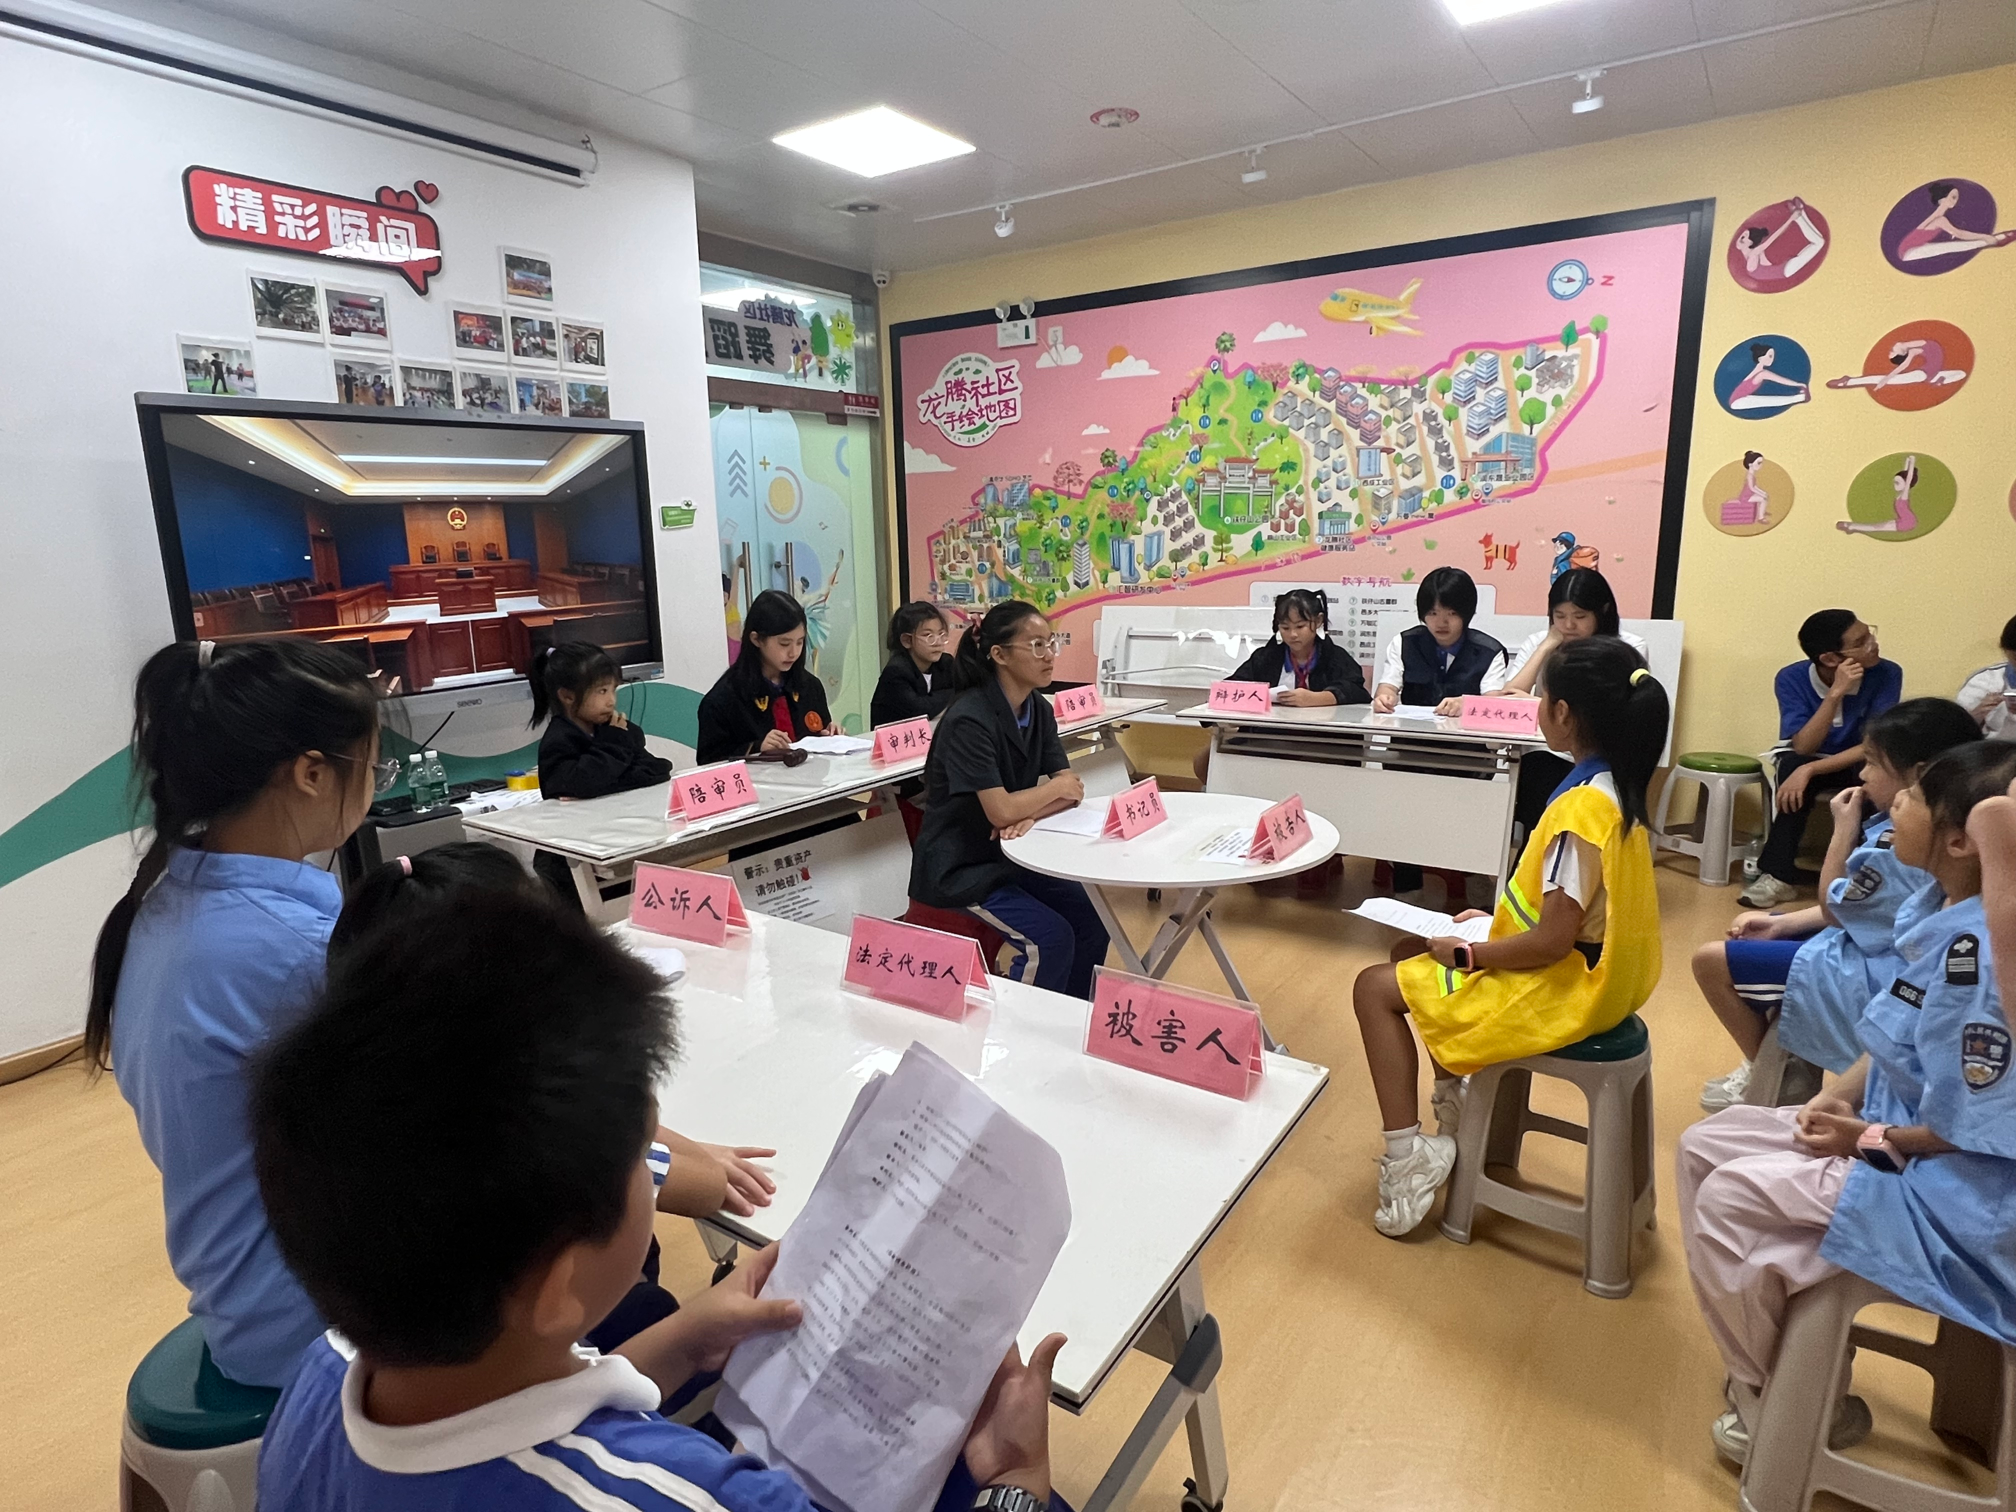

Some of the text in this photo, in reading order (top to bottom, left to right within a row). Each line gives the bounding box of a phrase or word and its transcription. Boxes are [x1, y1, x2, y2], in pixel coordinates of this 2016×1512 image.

[213, 183, 418, 261] 精彩瞬间
[1601, 275, 1615, 286] N
[921, 365, 1018, 420] 龙腾社区
[944, 398, 1016, 431] 手绘地图
[1065, 691, 1097, 711] 陪审员
[1215, 688, 1263, 704] 辩护人
[1467, 706, 1533, 722] 法定代理人
[888, 728, 931, 753] 审判长
[689, 773, 747, 805] 陪审员
[1126, 792, 1160, 826] 书记员
[1272, 809, 1306, 842] 被告人
[641, 882, 722, 921] 公诉人
[856, 944, 961, 985] 法定代理人
[1105, 999, 1241, 1065] 被害人
